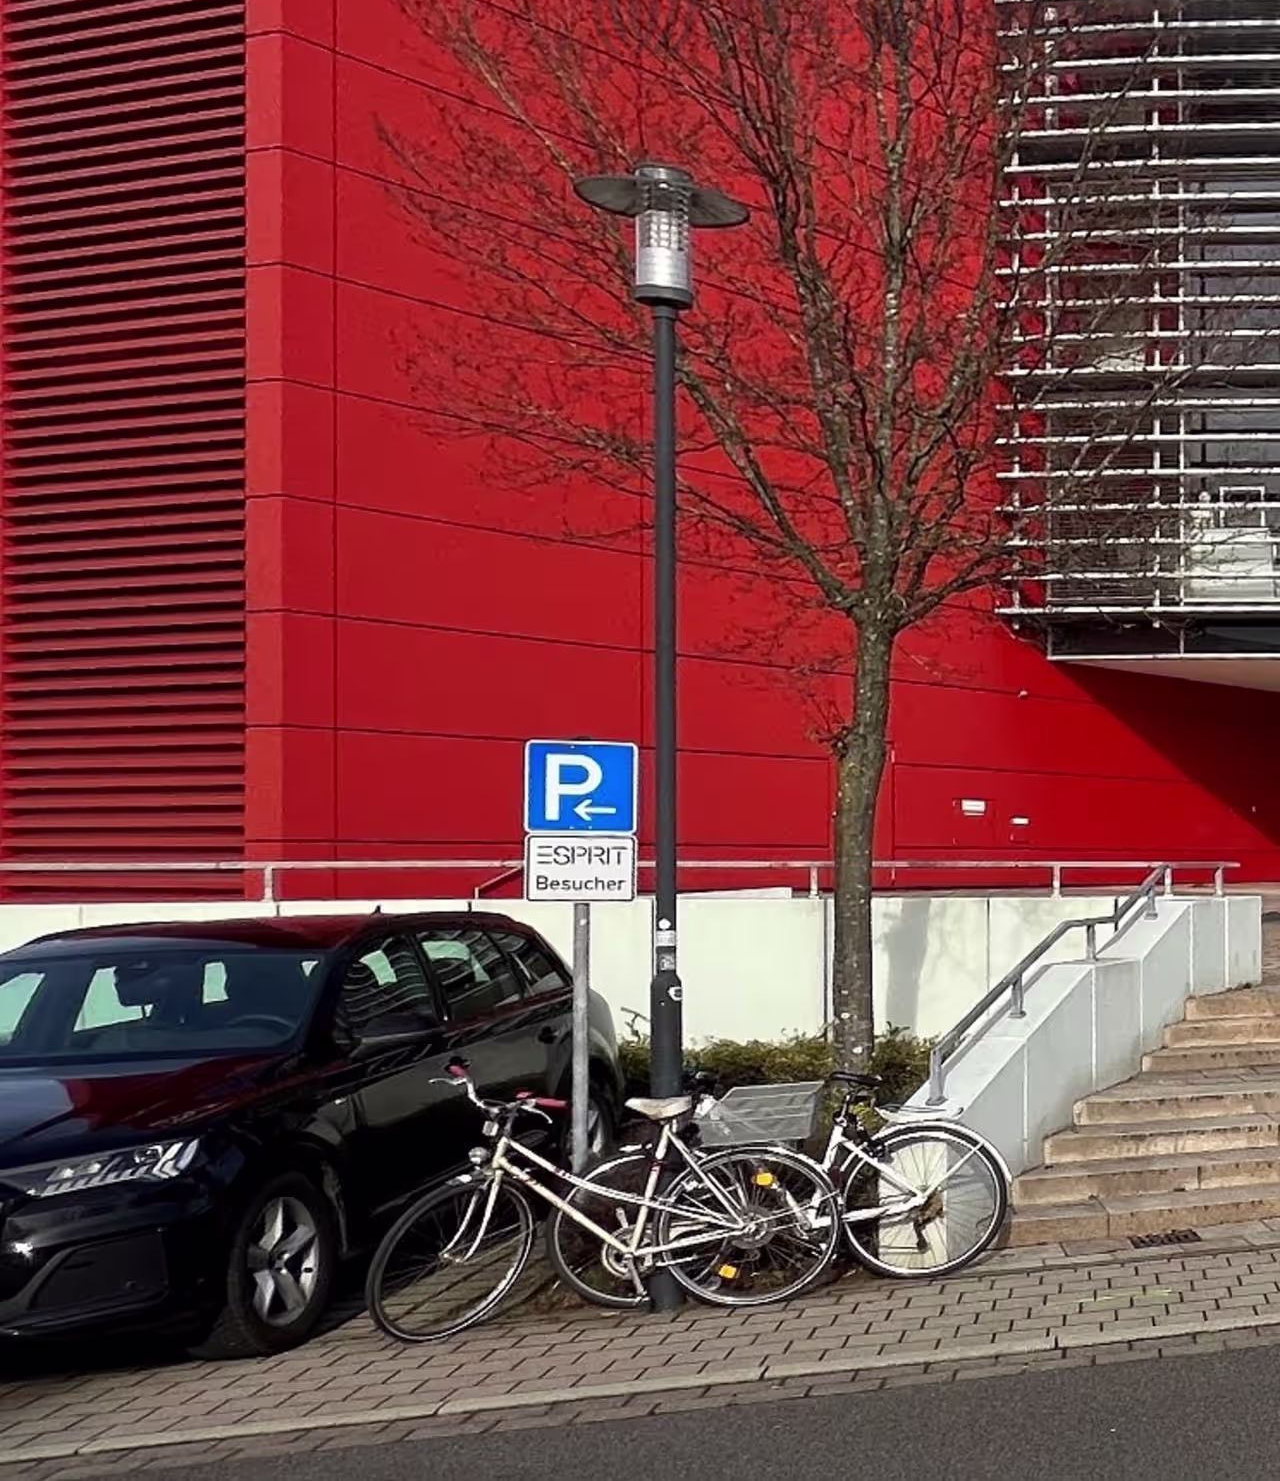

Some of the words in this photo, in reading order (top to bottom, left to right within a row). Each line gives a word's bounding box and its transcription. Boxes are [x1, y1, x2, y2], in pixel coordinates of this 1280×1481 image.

[545, 753, 603, 821] P
[536, 845, 629, 866] ESPRIT
[535, 874, 627, 892] Besucher
